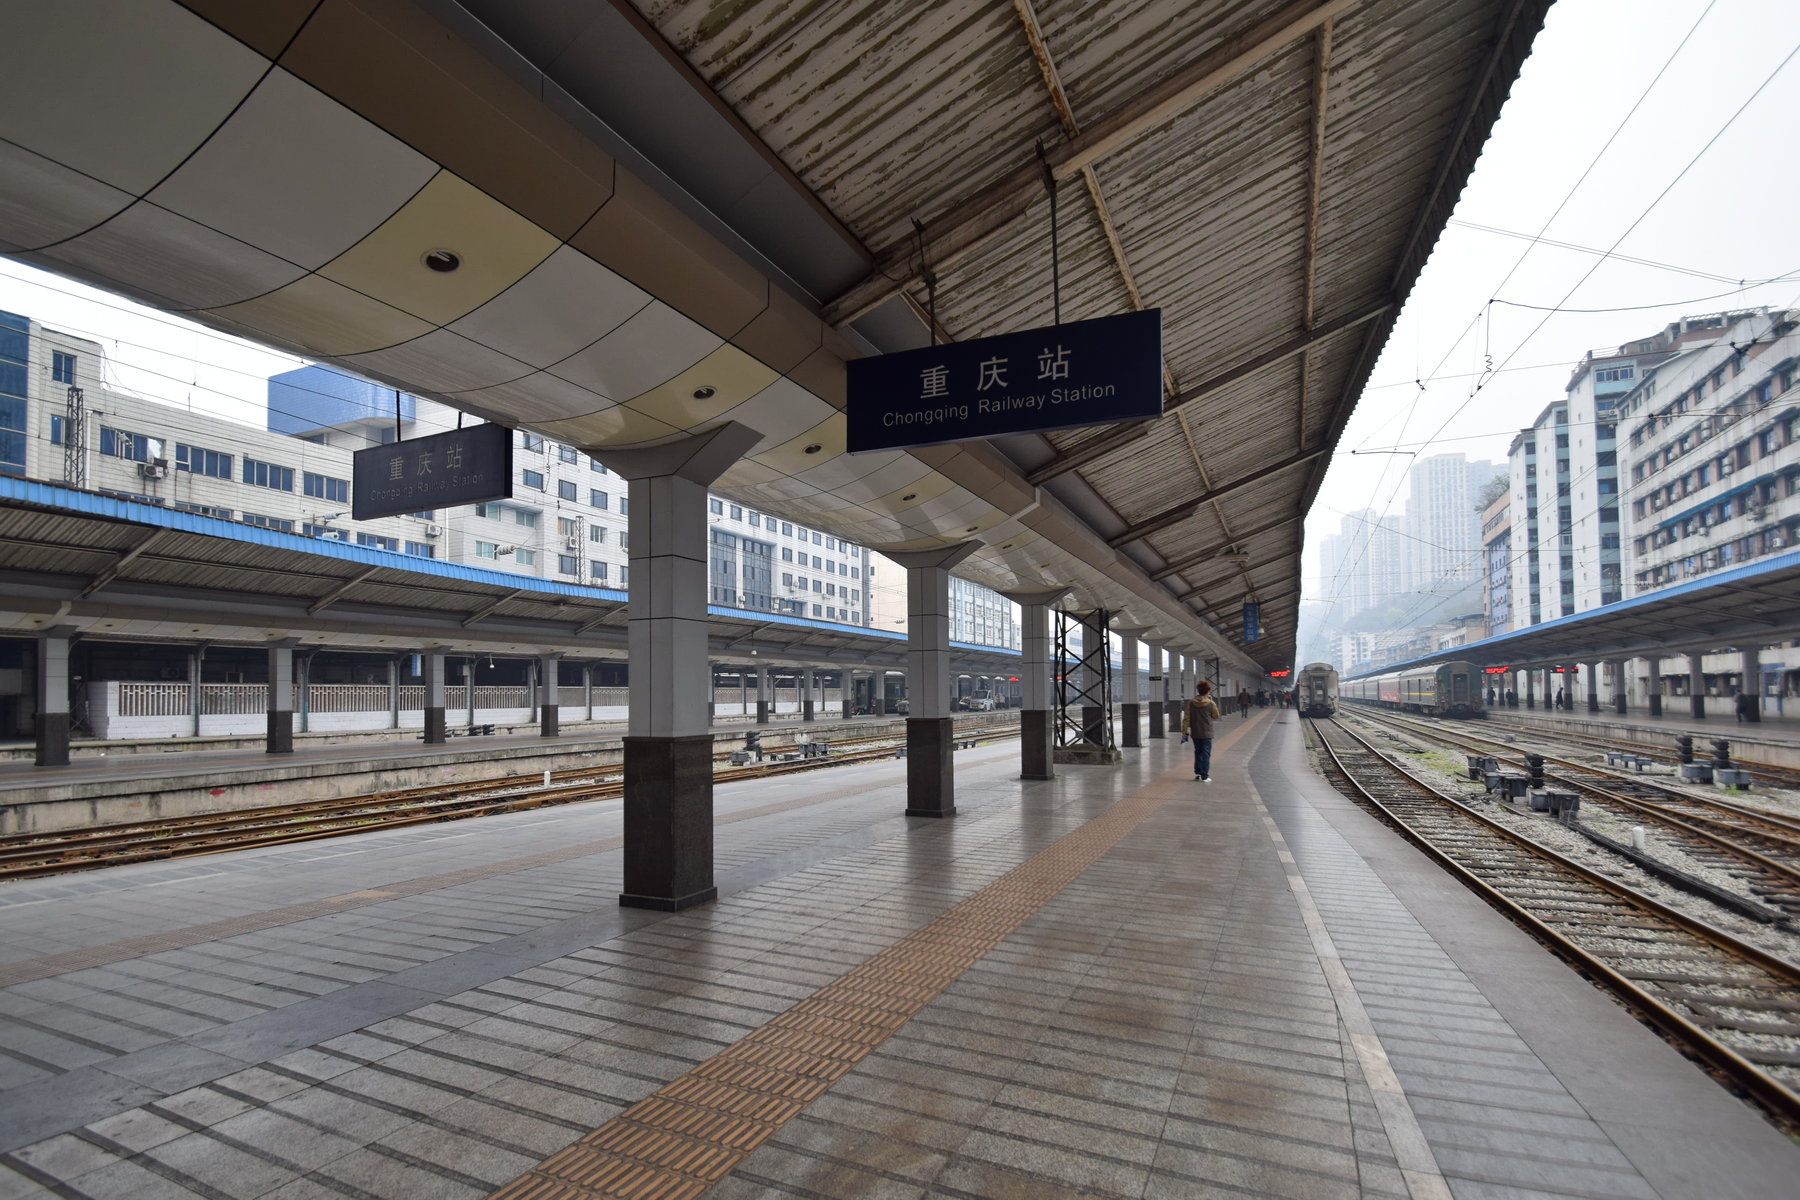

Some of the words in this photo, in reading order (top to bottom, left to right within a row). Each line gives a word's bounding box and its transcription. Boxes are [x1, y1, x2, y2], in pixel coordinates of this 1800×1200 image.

[919, 344, 1072, 399] 重庆站
[883, 402, 968, 427] Chongqing
[978, 391, 1046, 414] Railway
[1051, 383, 1115, 404] Station
[388, 443, 463, 481] 重庆站
[370, 486, 413, 501] Chongqng
[453, 474, 484, 488] Staton
